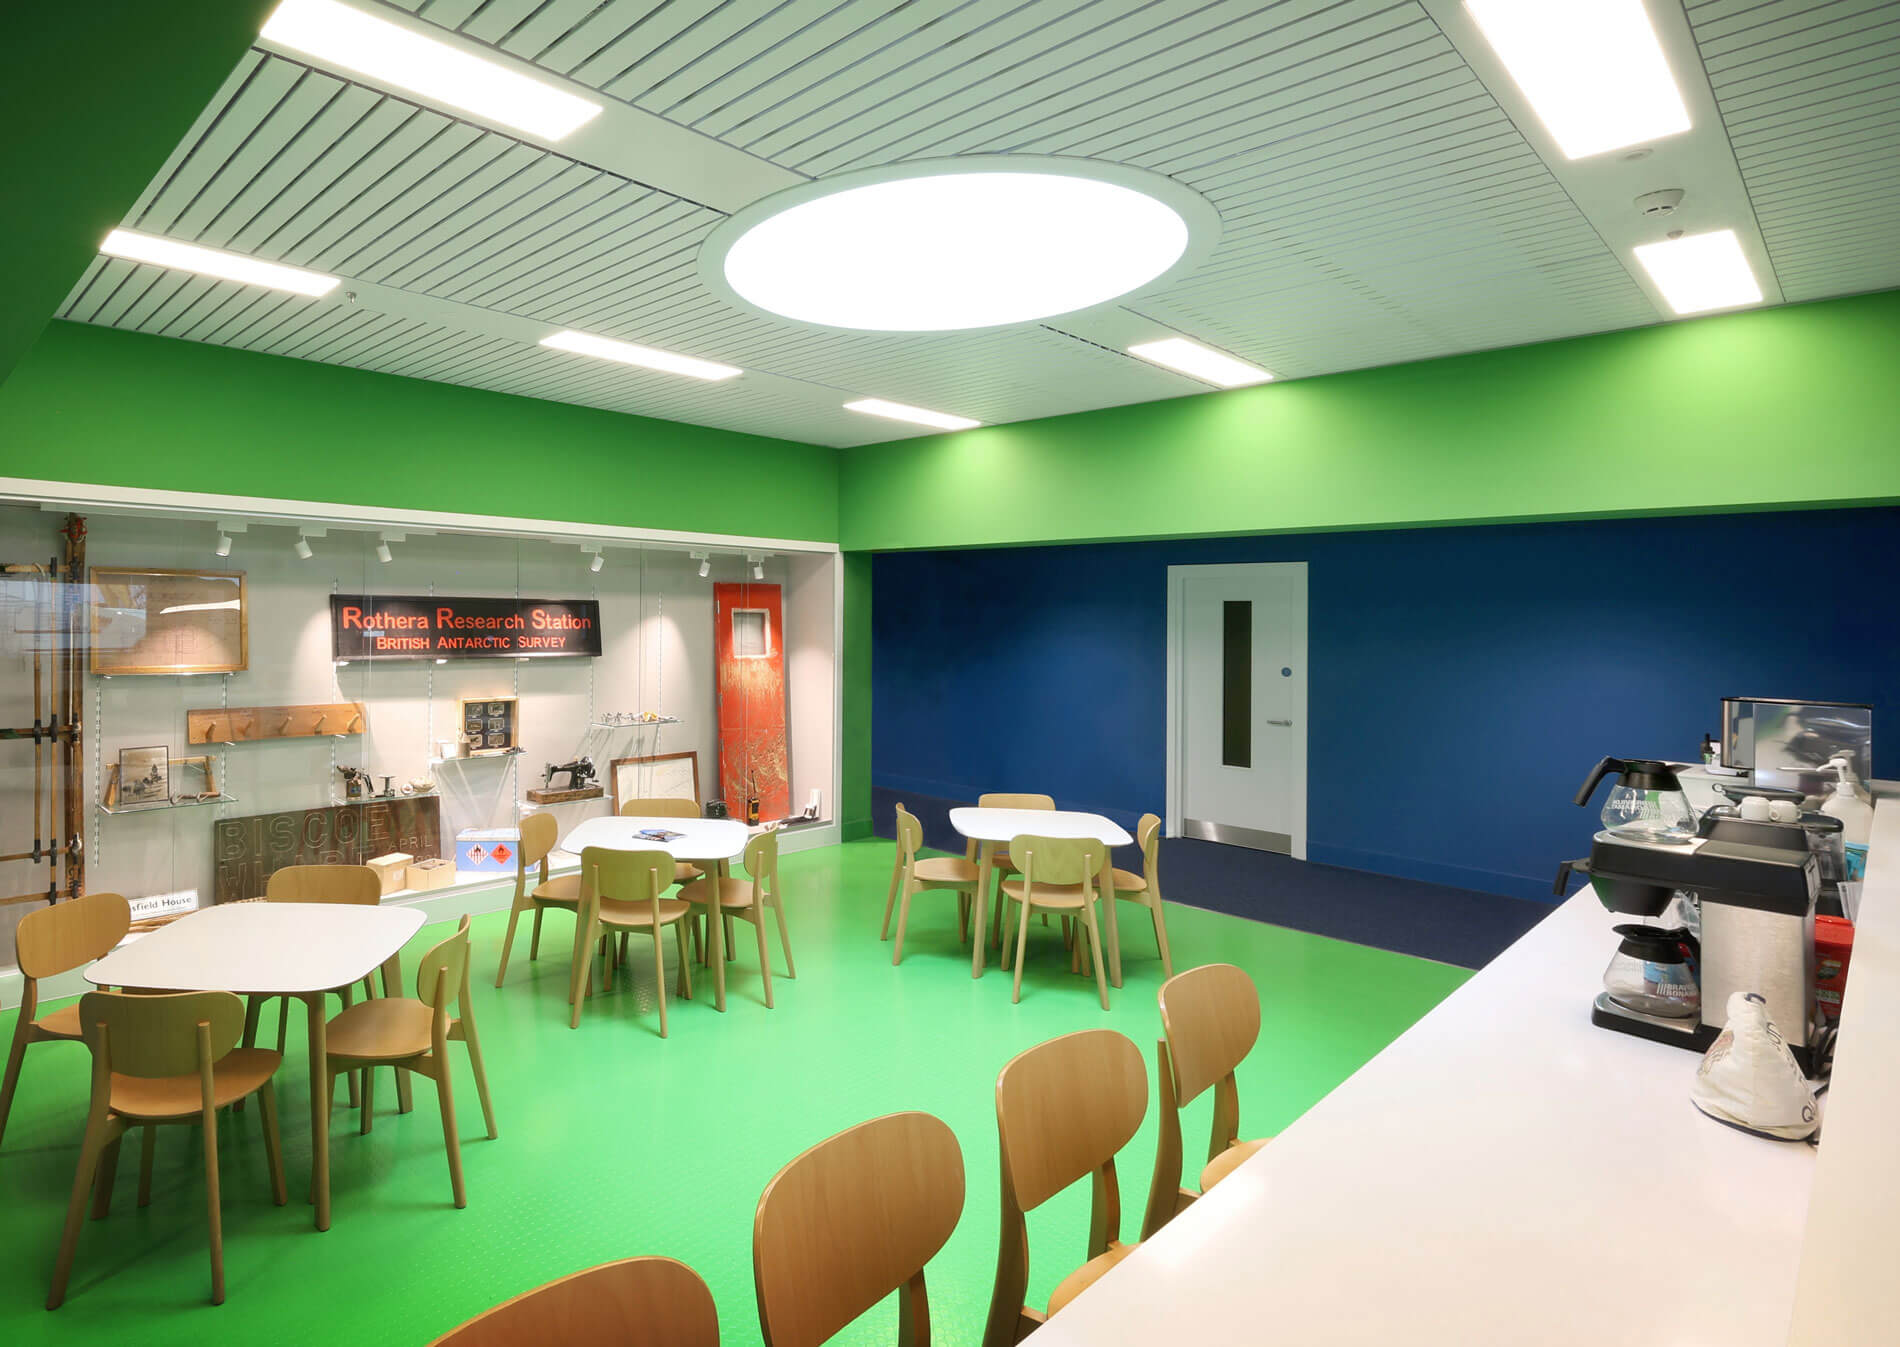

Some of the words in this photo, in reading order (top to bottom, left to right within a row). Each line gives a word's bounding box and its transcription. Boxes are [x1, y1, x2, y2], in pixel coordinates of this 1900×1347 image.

[342, 606, 429, 629] Rothera
[436, 607, 525, 630] Research
[531, 608, 592, 630] Station
[376, 636, 430, 650] BRITISH
[437, 636, 511, 649] ANTARCTIC
[518, 635, 566, 648] SURVEY
[218, 803, 389, 861] BISCOE
[388, 835, 433, 850] APRIL
[131, 900, 158, 912] sfield
[161, 896, 192, 907] House
